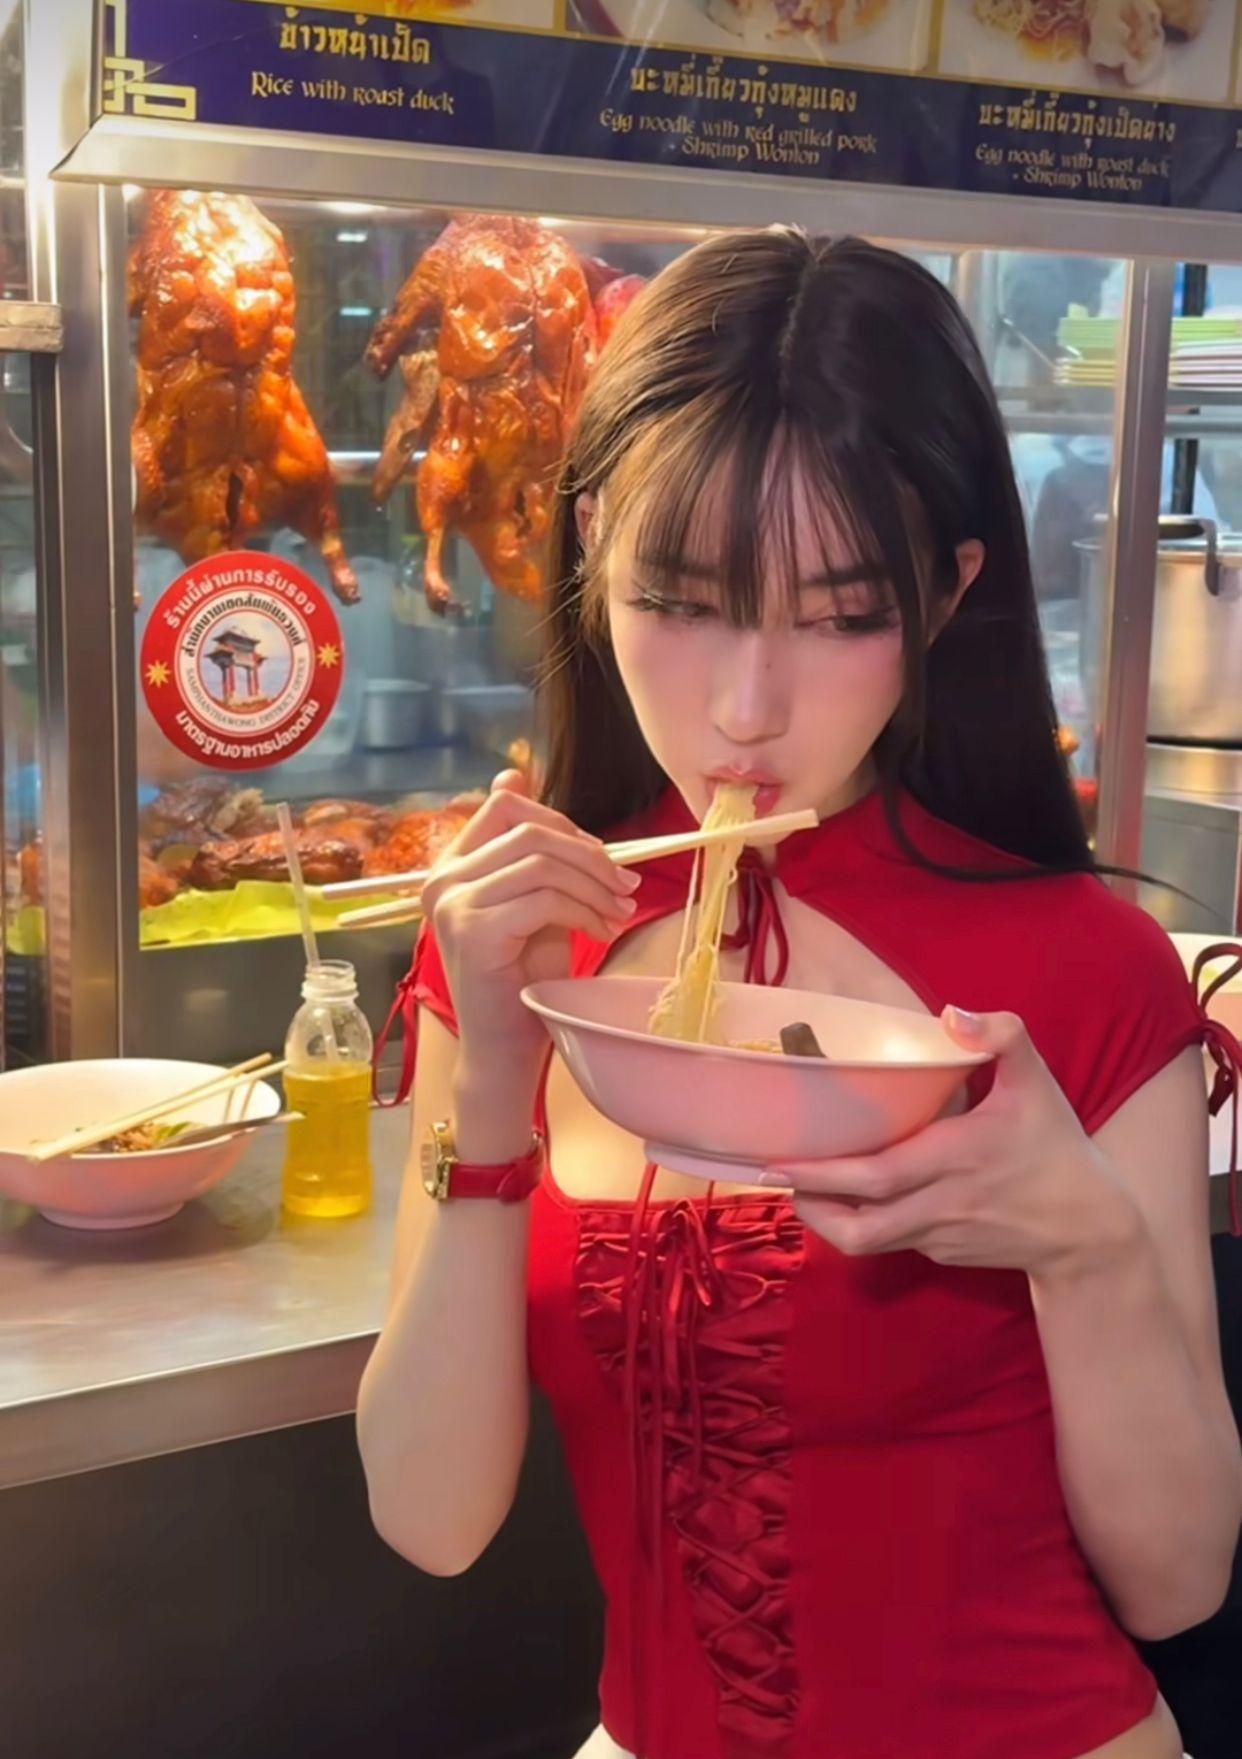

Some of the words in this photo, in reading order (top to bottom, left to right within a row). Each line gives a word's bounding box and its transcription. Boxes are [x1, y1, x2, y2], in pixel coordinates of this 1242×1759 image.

[279, 6, 431, 64] ข้าวหน้าเป็ด
[251, 70, 294, 98] Rice
[301, 78, 347, 101] with
[353, 86, 404, 107] roast
[410, 89, 454, 115] duck
[600, 108, 633, 133] Egg
[640, 115, 695, 135] noodle
[702, 119, 739, 139] with
[745, 123, 774, 143] red
[779, 126, 832, 148] grilled
[838, 133, 877, 153] pork
[682, 135, 749, 162] Shrimp
[755, 141, 821, 165] Wonton
[975, 143, 1003, 166] Egg
[1008, 148, 1054, 167] noodle
[1061, 151, 1093, 169] with
[1137, 158, 1169, 178] duck
[1023, 165, 1082, 189] Shrimp
[1087, 171, 1142, 191] Wonton
[163, 568, 317, 629] ร้านนี้ผ่านการรับรอง
[175, 698, 320, 759] มาตรฐานอาหารปลอดภัย
